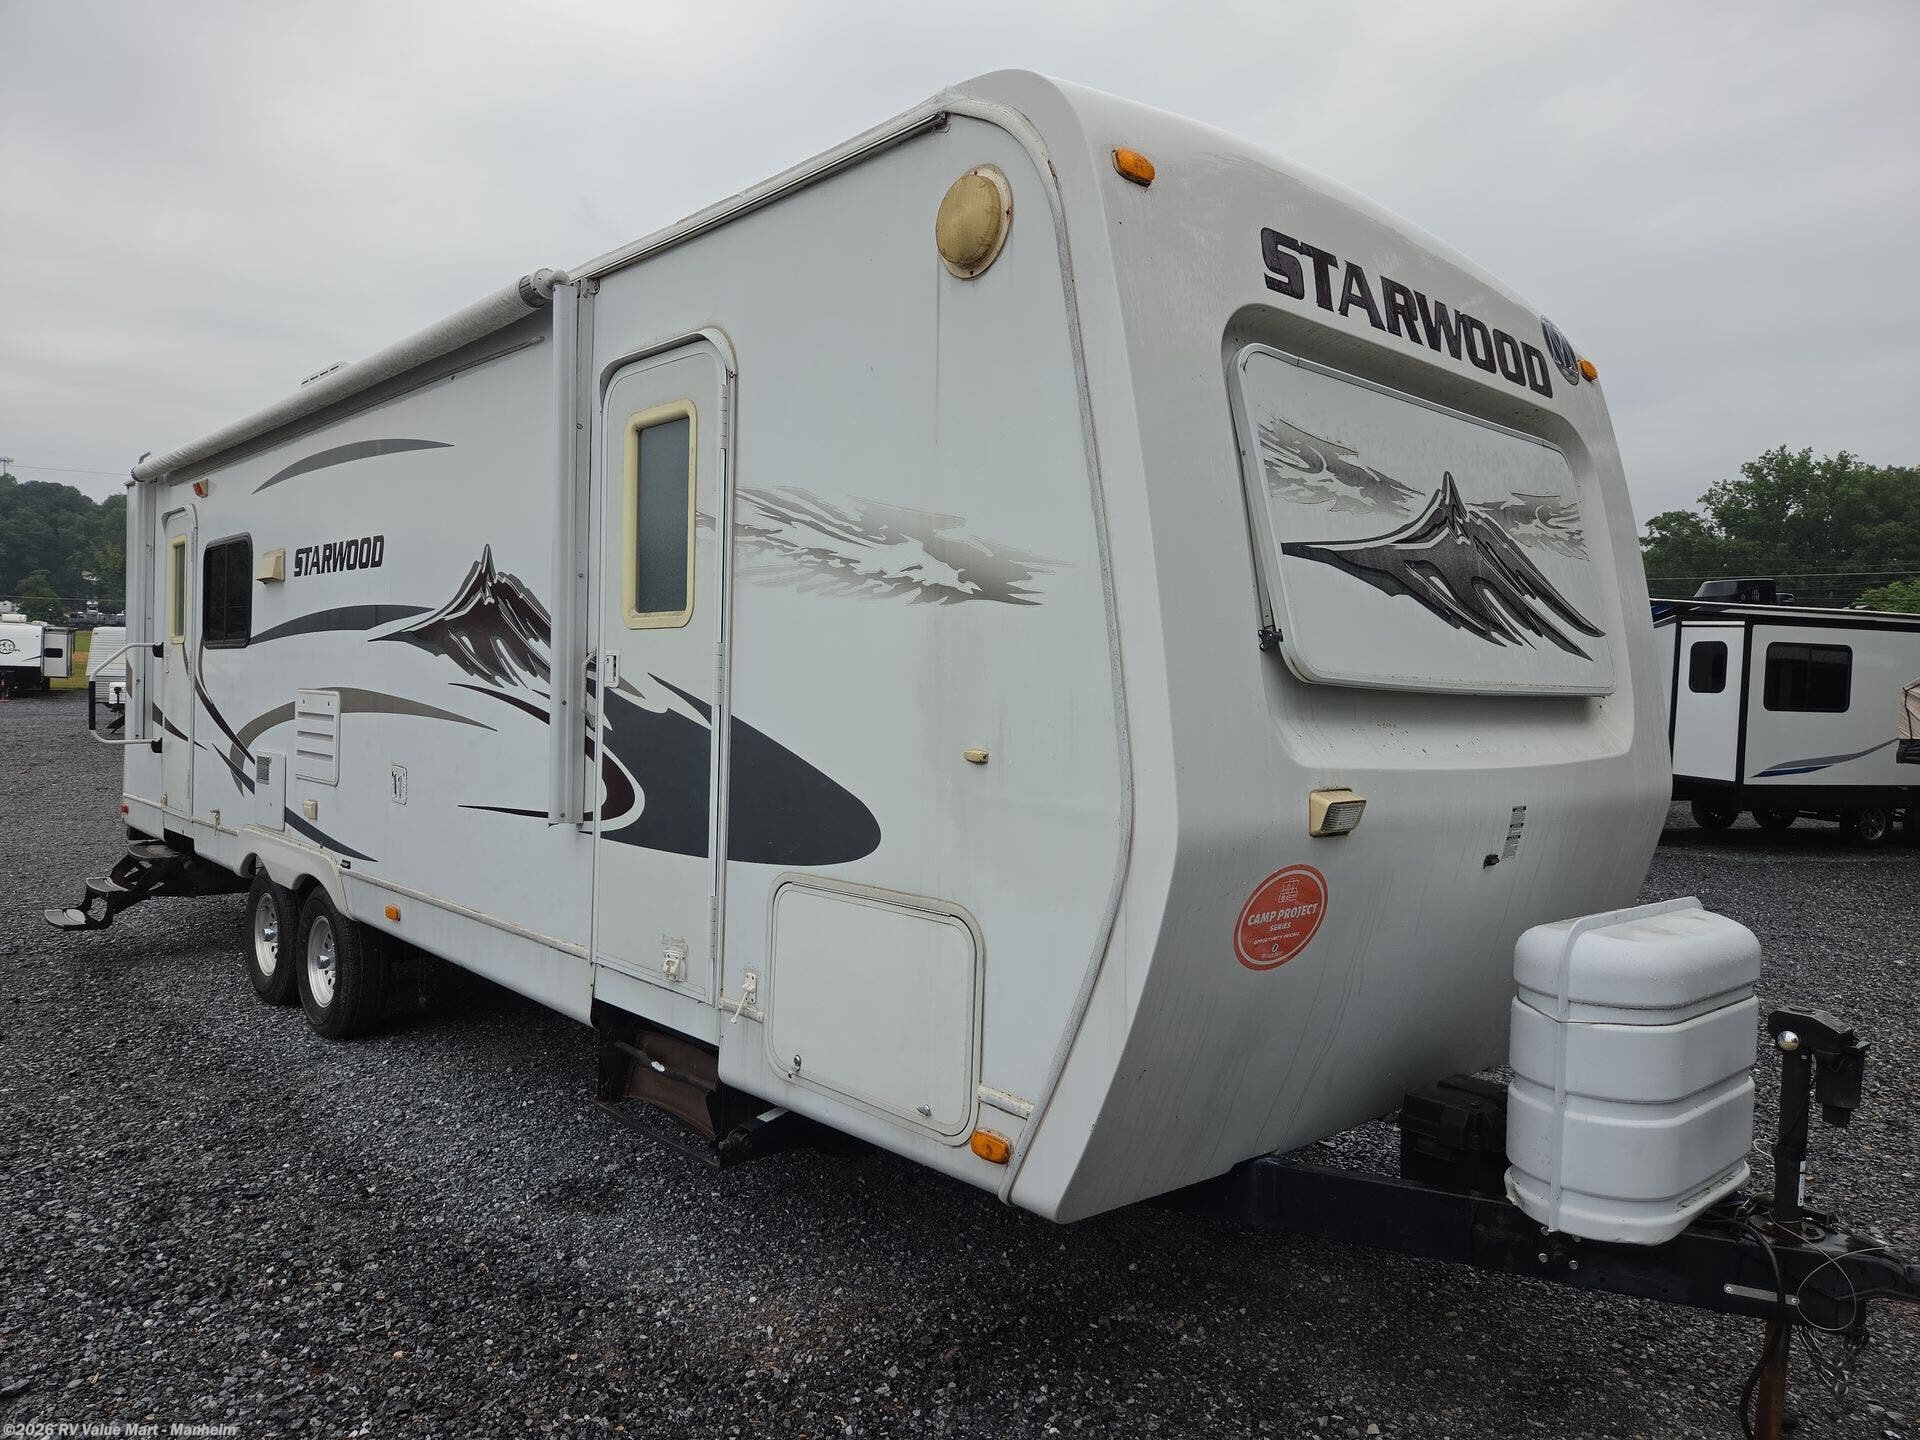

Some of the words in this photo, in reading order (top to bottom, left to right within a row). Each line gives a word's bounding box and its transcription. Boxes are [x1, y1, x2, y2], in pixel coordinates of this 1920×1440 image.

[1260, 226, 1553, 399] STARWOOD
[293, 534, 385, 578] STARWOOD
[1247, 911, 1277, 927] CAMP
[1277, 903, 1319, 921] PROJECT
[1269, 921, 1292, 932] SERIES
